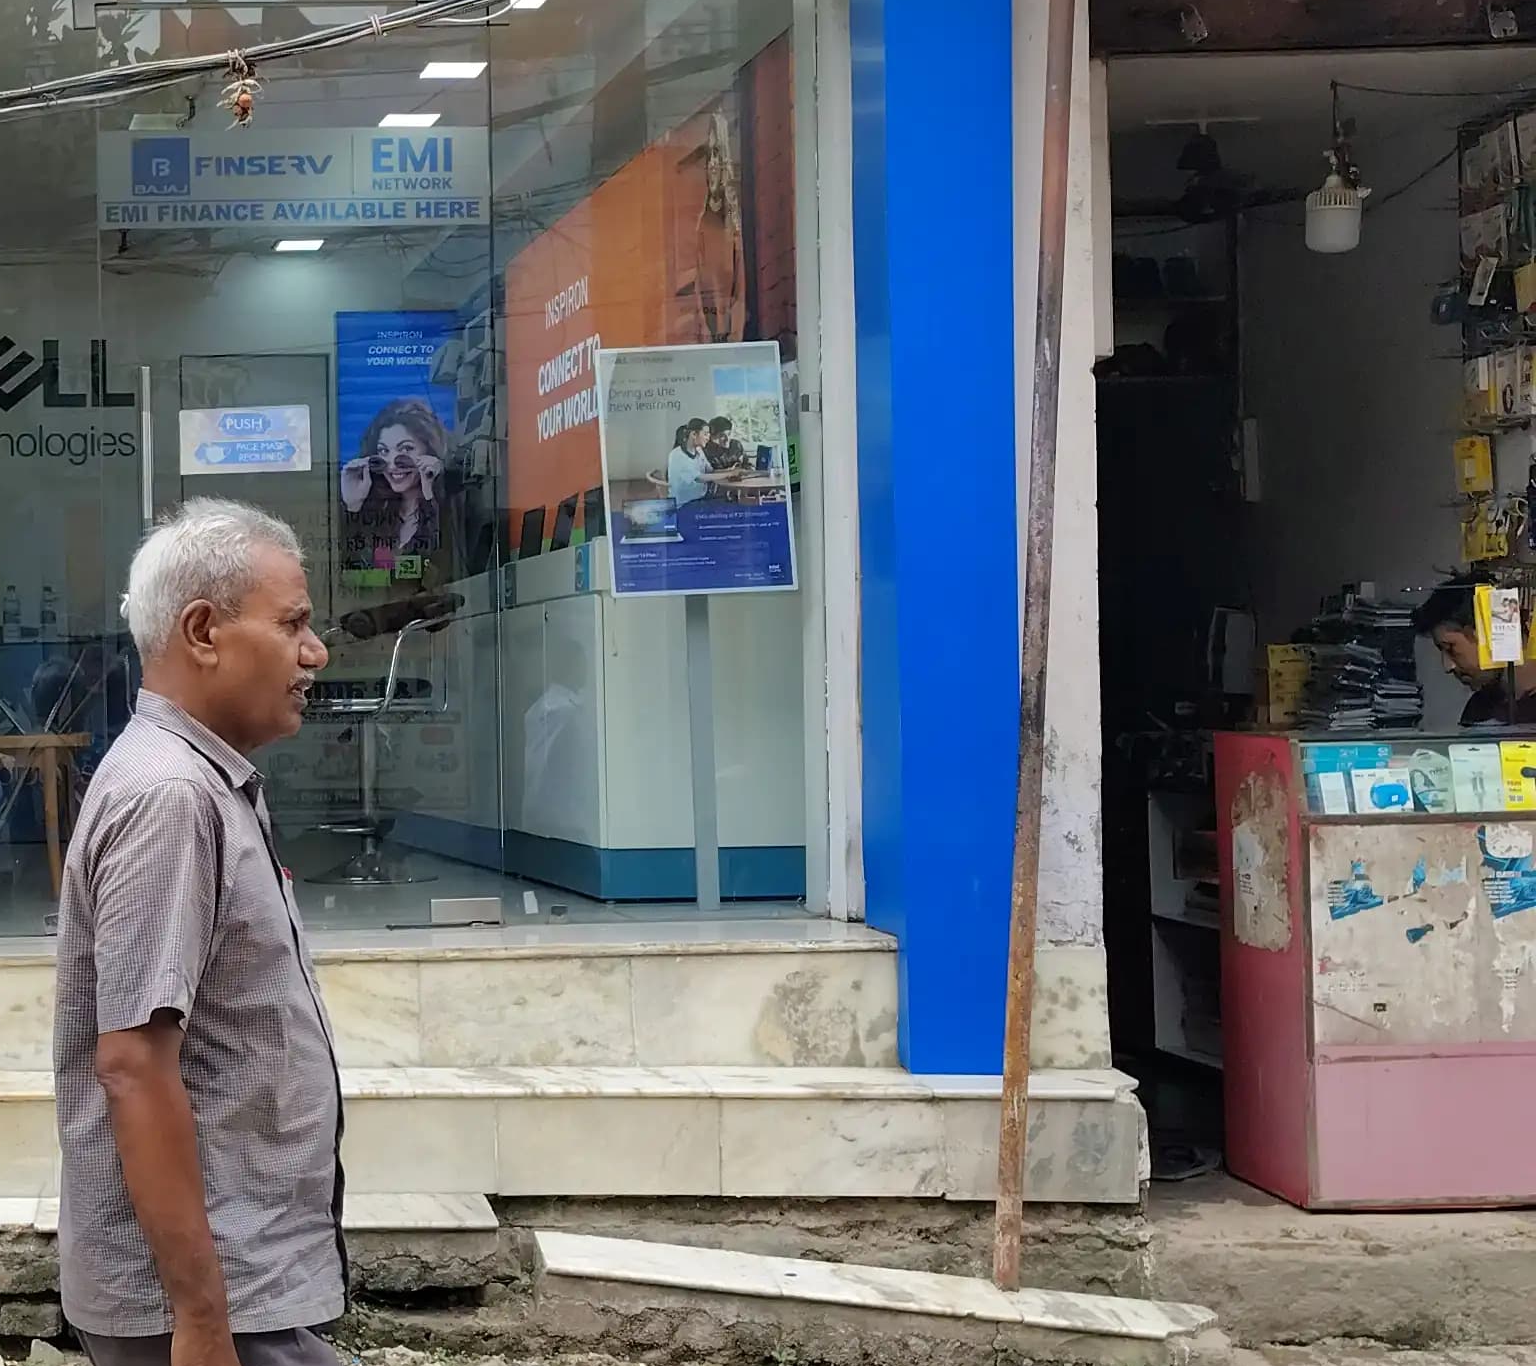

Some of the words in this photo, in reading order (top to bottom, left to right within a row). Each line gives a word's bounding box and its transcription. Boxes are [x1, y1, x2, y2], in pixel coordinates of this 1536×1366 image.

[194, 154, 336, 178] FINSERV
[371, 136, 453, 174] EMI
[134, 184, 189, 196] BAJAJ
[371, 177, 453, 191] NETWORK
[105, 204, 148, 224] EMI
[157, 203, 264, 224] FINANCE
[272, 201, 406, 223] AVAILABLE
[415, 200, 481, 220] HERE
[545, 275, 589, 331] INSPIRON
[366, 356, 397, 366] YOUR
[368, 344, 418, 355] CONNECT
[421, 344, 434, 354] TO
[538, 345, 585, 397] CONNECT
[225, 418, 263, 430] PUSH
[537, 402, 563, 444] YOUR
